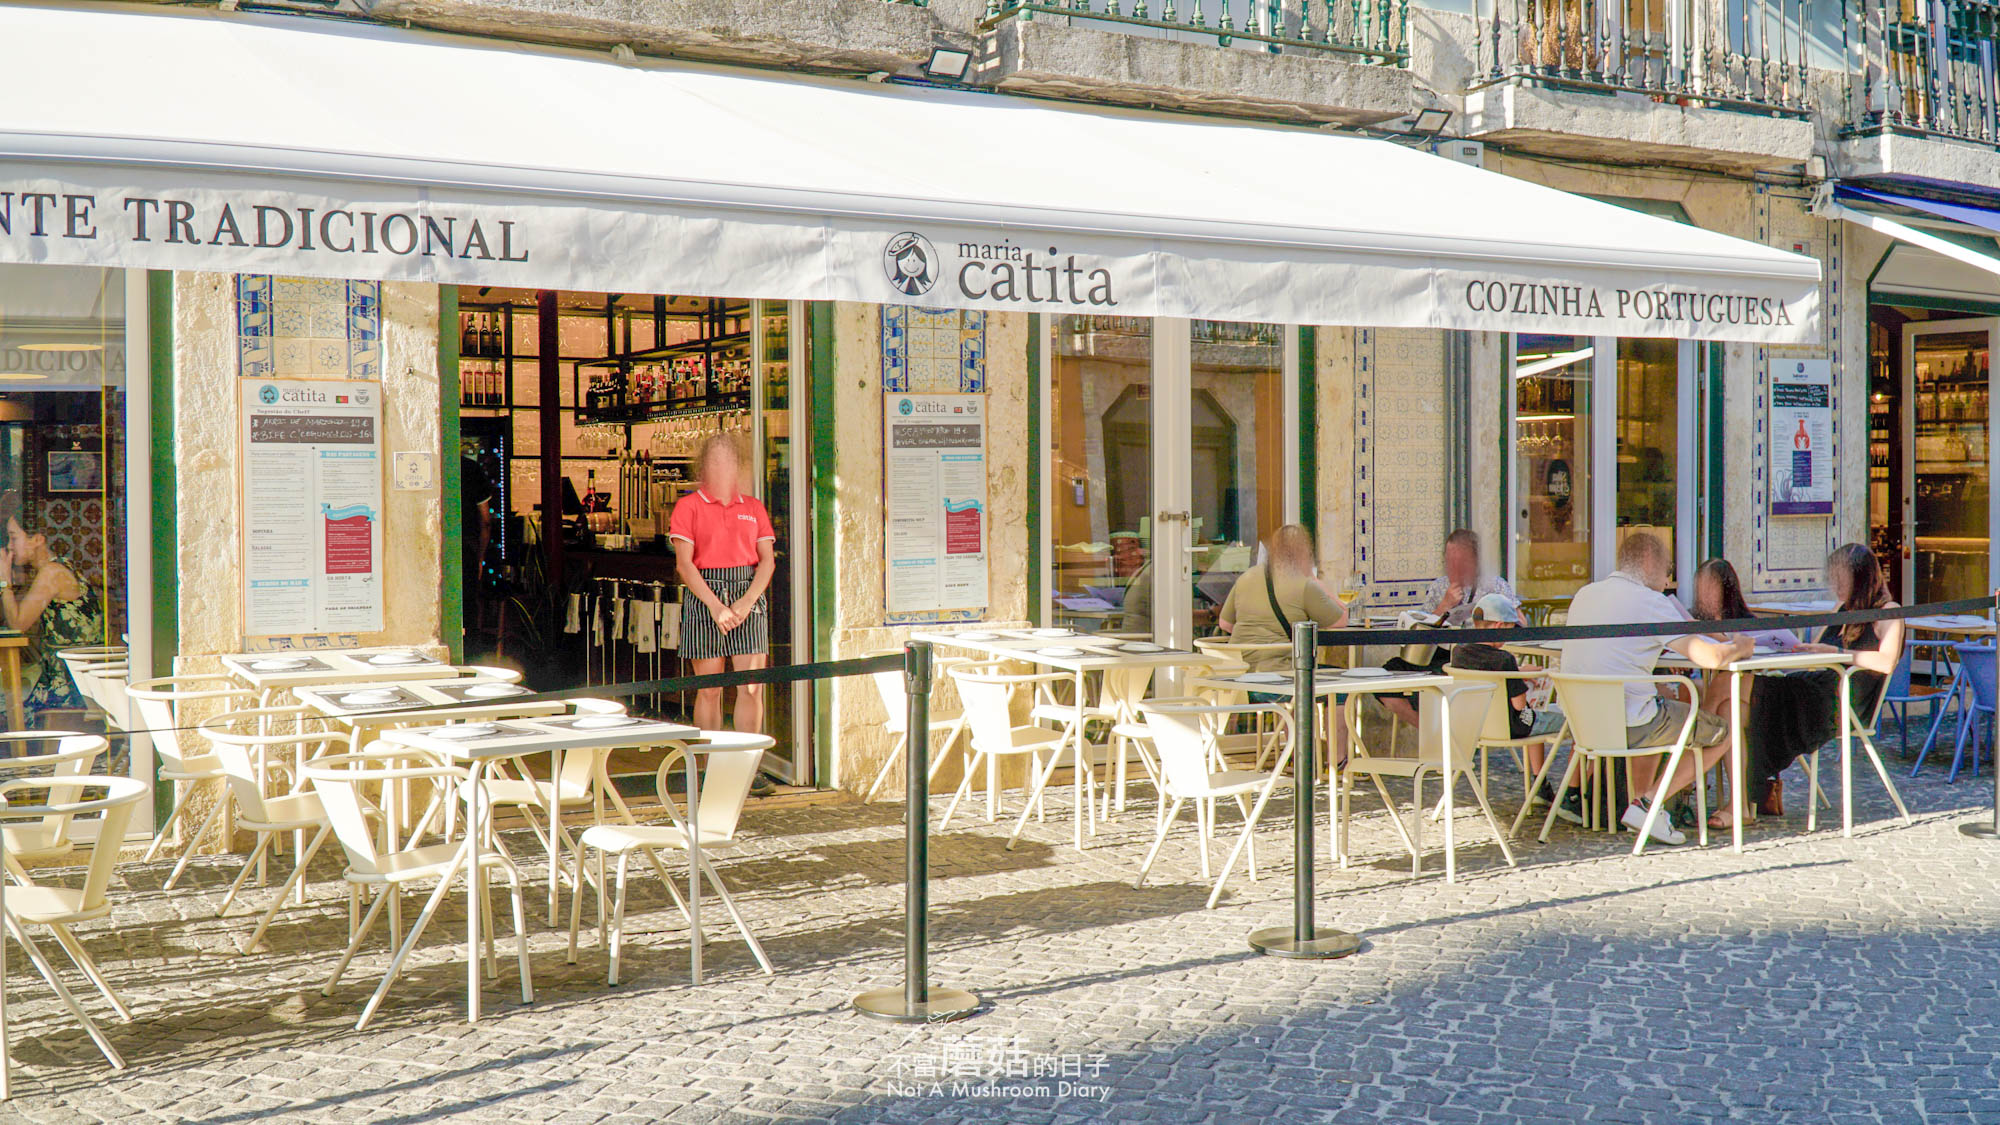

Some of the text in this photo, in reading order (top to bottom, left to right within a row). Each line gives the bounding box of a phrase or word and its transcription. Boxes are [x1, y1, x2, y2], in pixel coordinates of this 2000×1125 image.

[124, 197, 529, 263] TRADICIONAL
[958, 238, 1024, 262] maria
[957, 246, 1118, 307] catita
[1466, 280, 1795, 326] COZINHA PORTUGUESA
[282, 388, 327, 403] catita
[915, 401, 947, 413] catita
